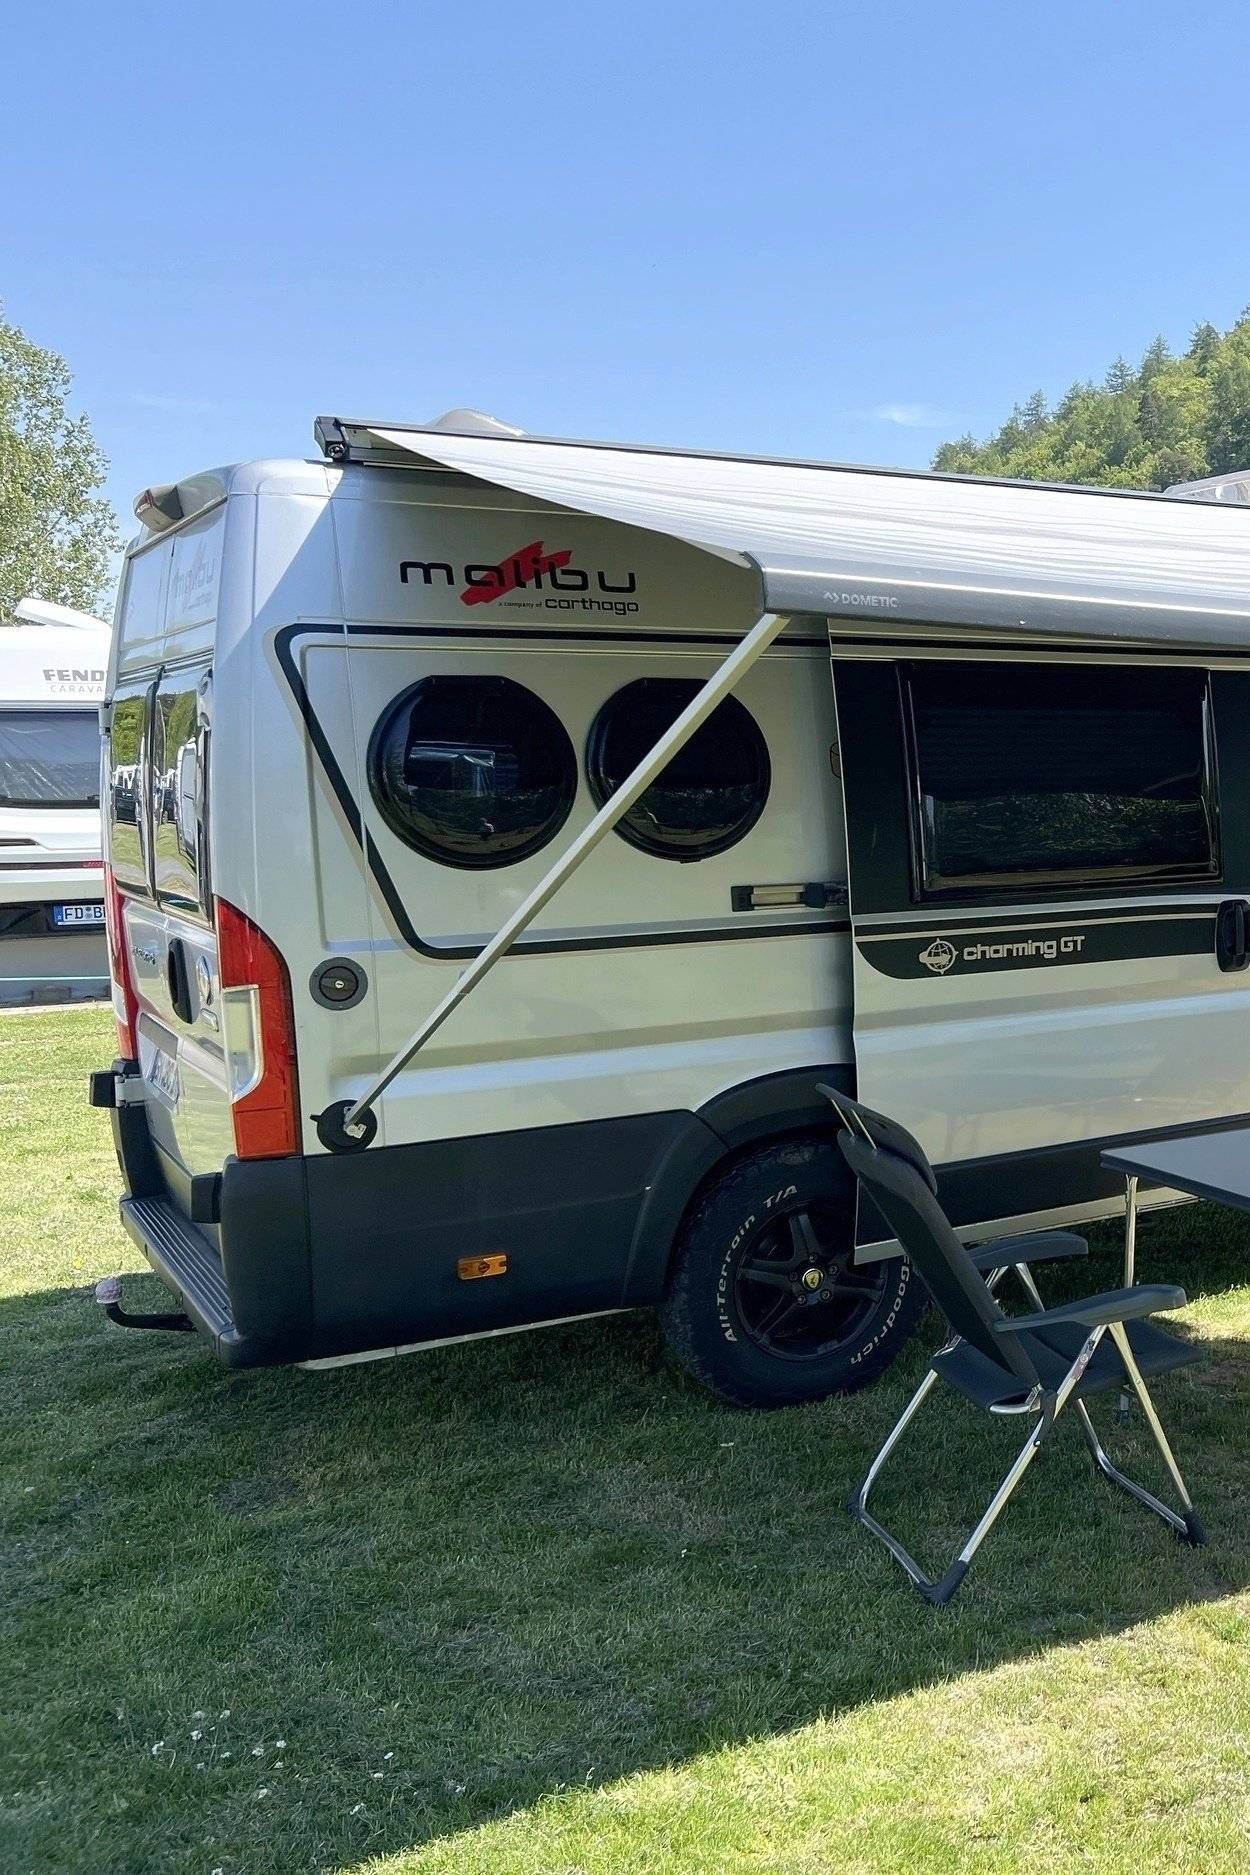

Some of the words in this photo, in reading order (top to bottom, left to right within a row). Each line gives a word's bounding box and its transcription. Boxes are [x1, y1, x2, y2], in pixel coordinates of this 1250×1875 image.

[400, 557, 636, 594] malibu
[545, 598, 639, 616] carthago
[841, 593, 898, 608] DOMETIC
[43, 669, 108, 682] FEND
[50, 684, 104, 694] CARAVA
[64, 907, 83, 920] FD
[963, 939, 1057, 961] charming
[1060, 935, 1086, 953] GT
[716, 1214, 755, 1342] All-Terrain
[763, 1185, 798, 1208] T/A
[850, 1254, 910, 1365] Goodrich
